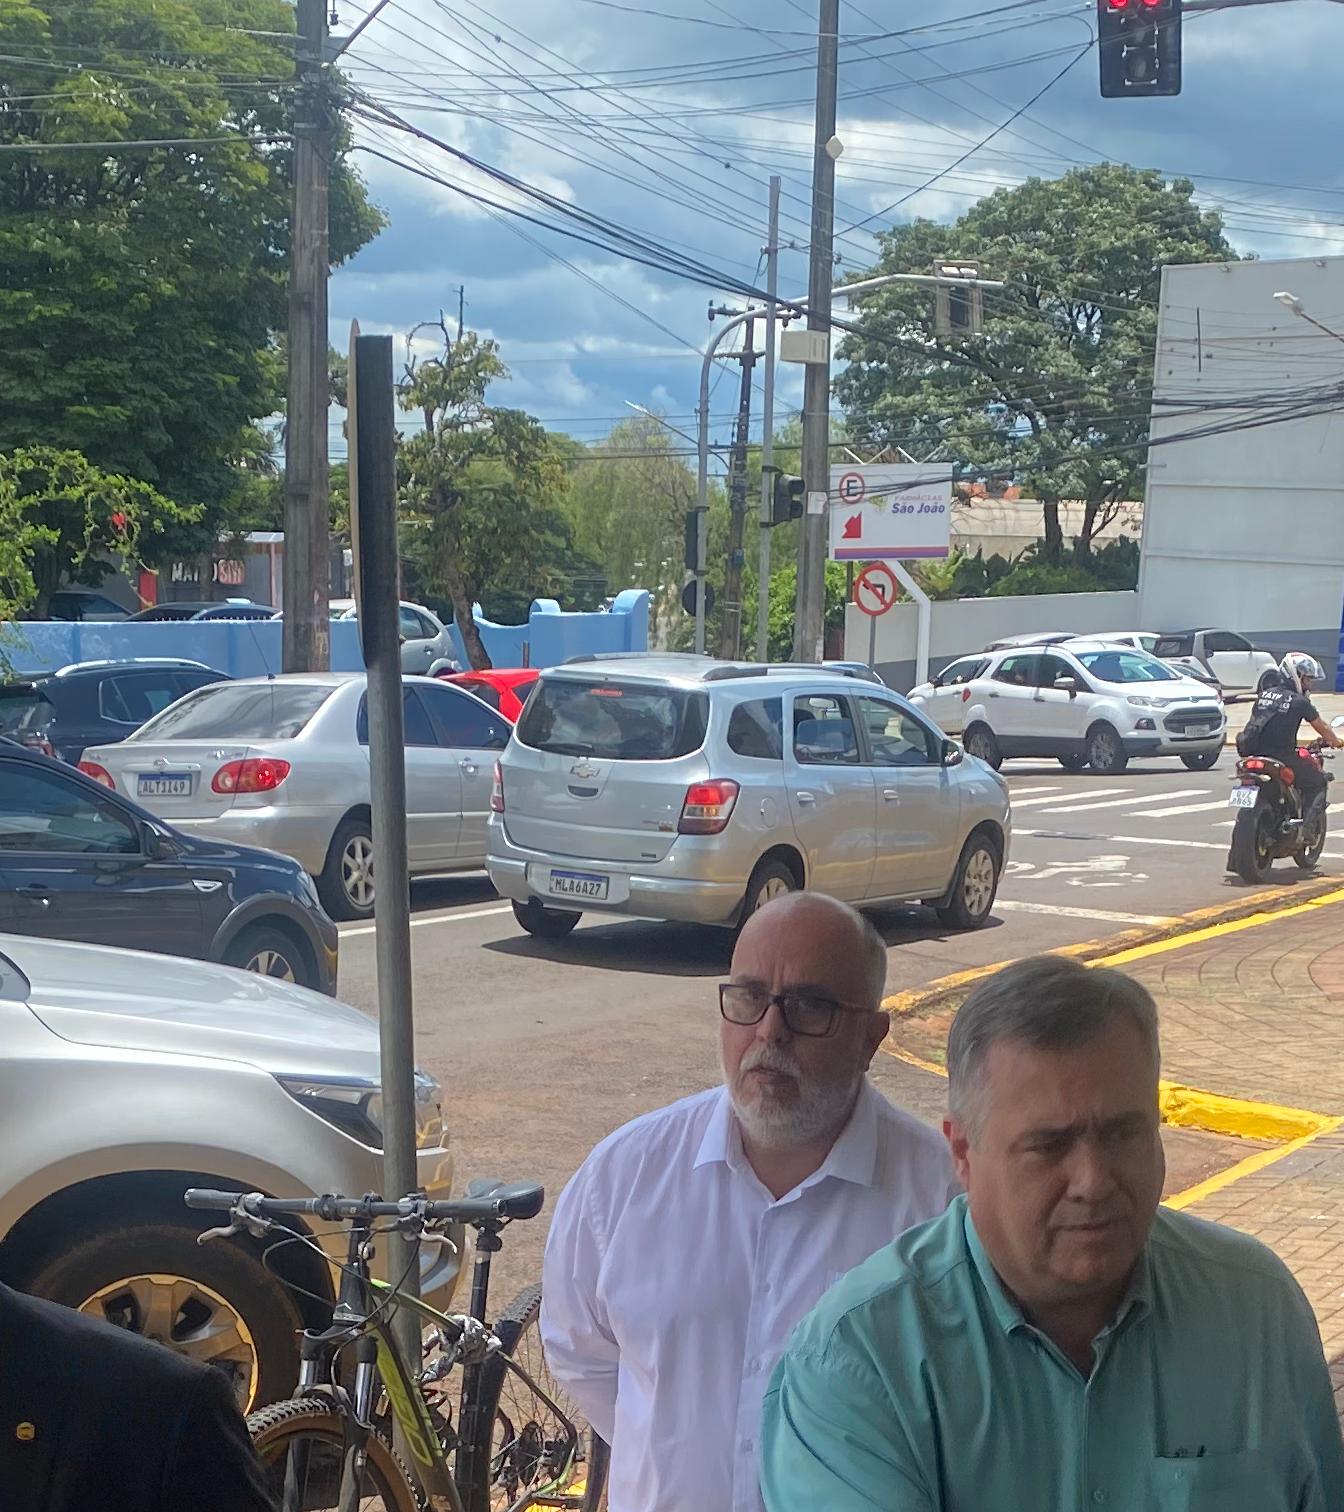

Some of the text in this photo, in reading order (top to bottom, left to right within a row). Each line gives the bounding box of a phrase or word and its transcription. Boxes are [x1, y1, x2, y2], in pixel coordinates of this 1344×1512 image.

[846, 479, 858, 497] E
[917, 501, 945, 514] João
[555, 878, 601, 896] MLA6A27
